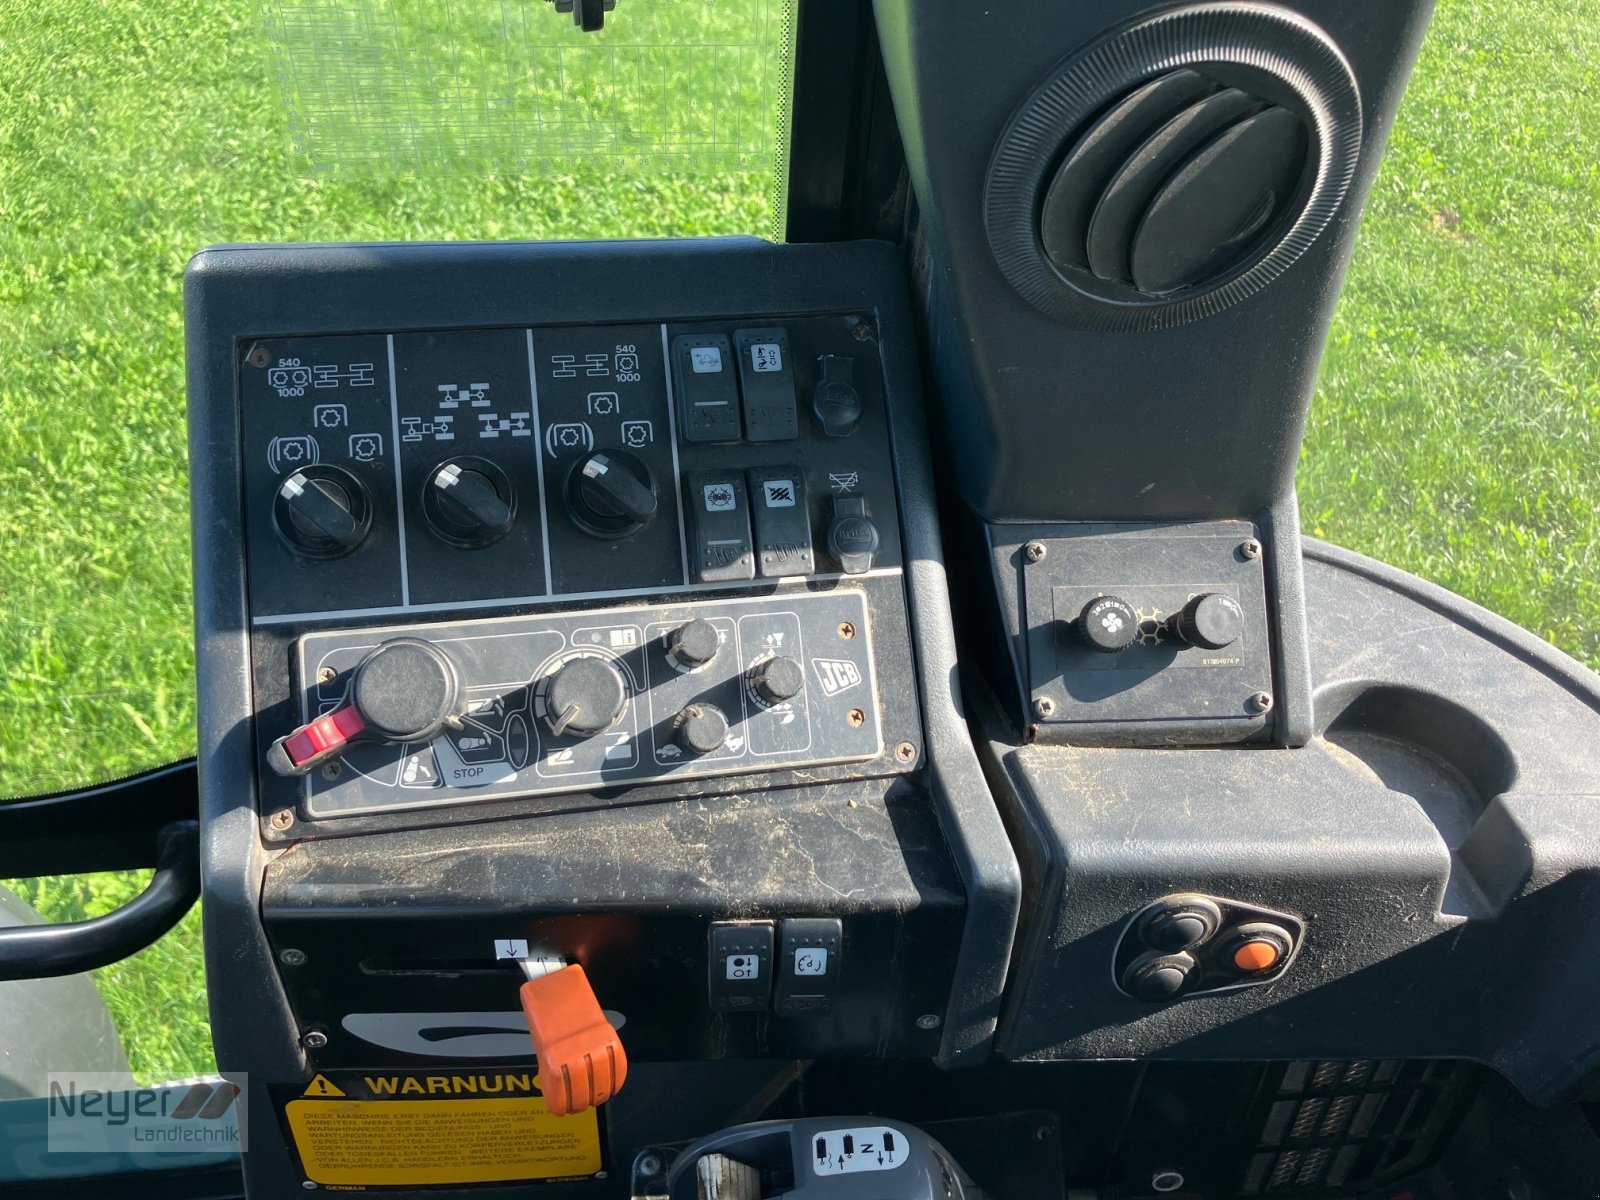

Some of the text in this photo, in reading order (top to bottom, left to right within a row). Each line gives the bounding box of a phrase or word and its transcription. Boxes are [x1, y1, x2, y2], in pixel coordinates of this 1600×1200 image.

[615, 344, 636, 353] 540
[279, 358, 301, 367] 540
[615, 373, 641, 382] 1000
[278, 388, 305, 397] 1000
[820, 661, 859, 691] JCB
[454, 767, 484, 779] STOP
